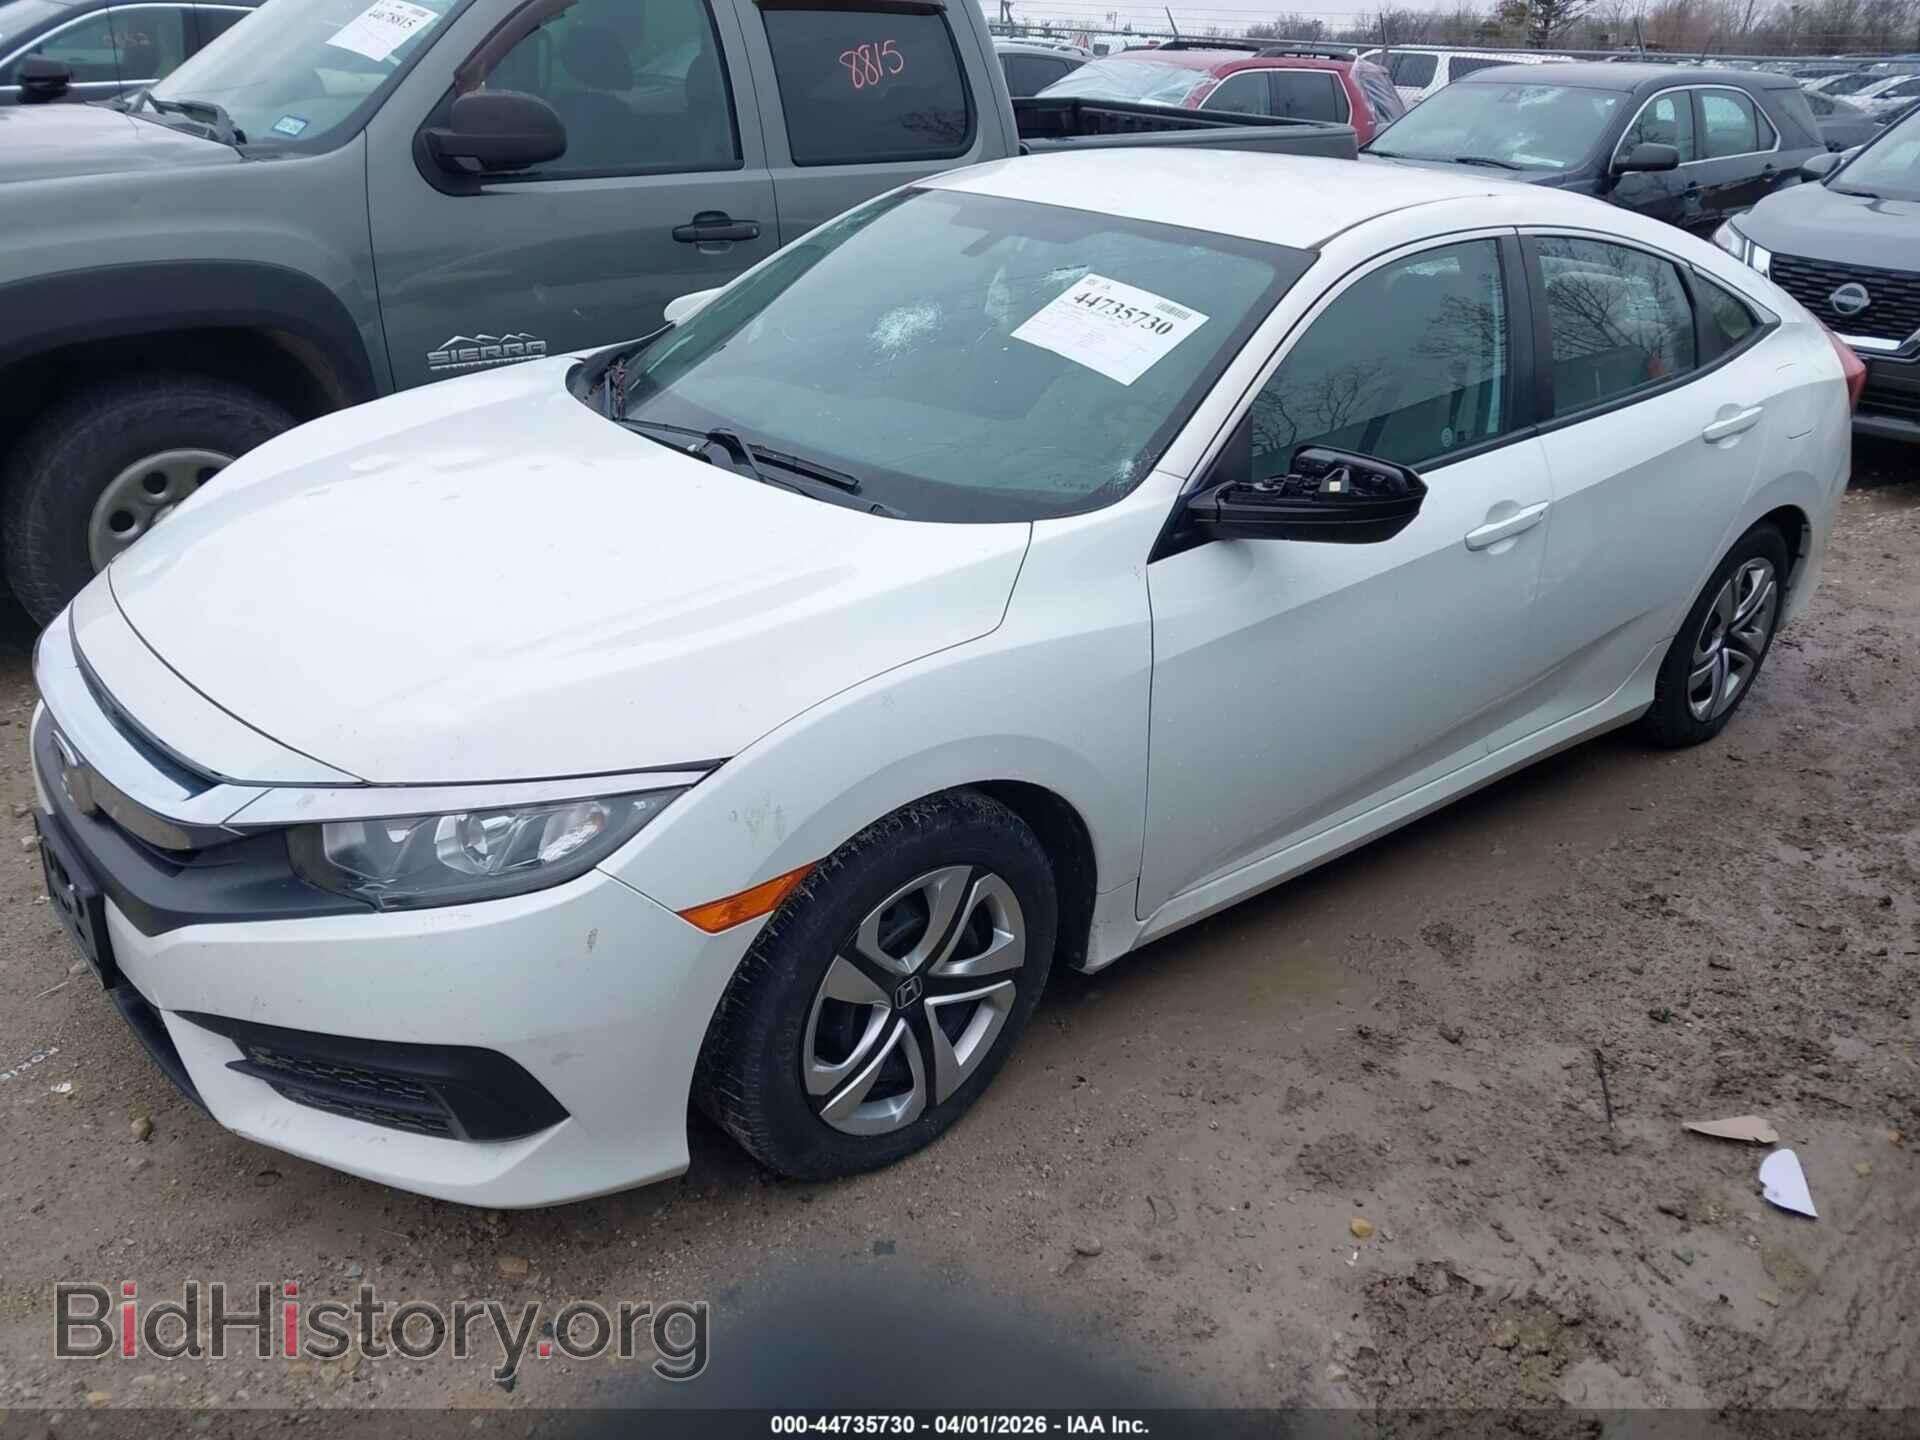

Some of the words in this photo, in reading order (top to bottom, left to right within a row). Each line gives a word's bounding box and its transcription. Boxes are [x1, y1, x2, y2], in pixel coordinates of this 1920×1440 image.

[839, 39, 904, 89] 8815
[1073, 292, 1174, 336] 44735730
[426, 340, 546, 364] SIERRA
